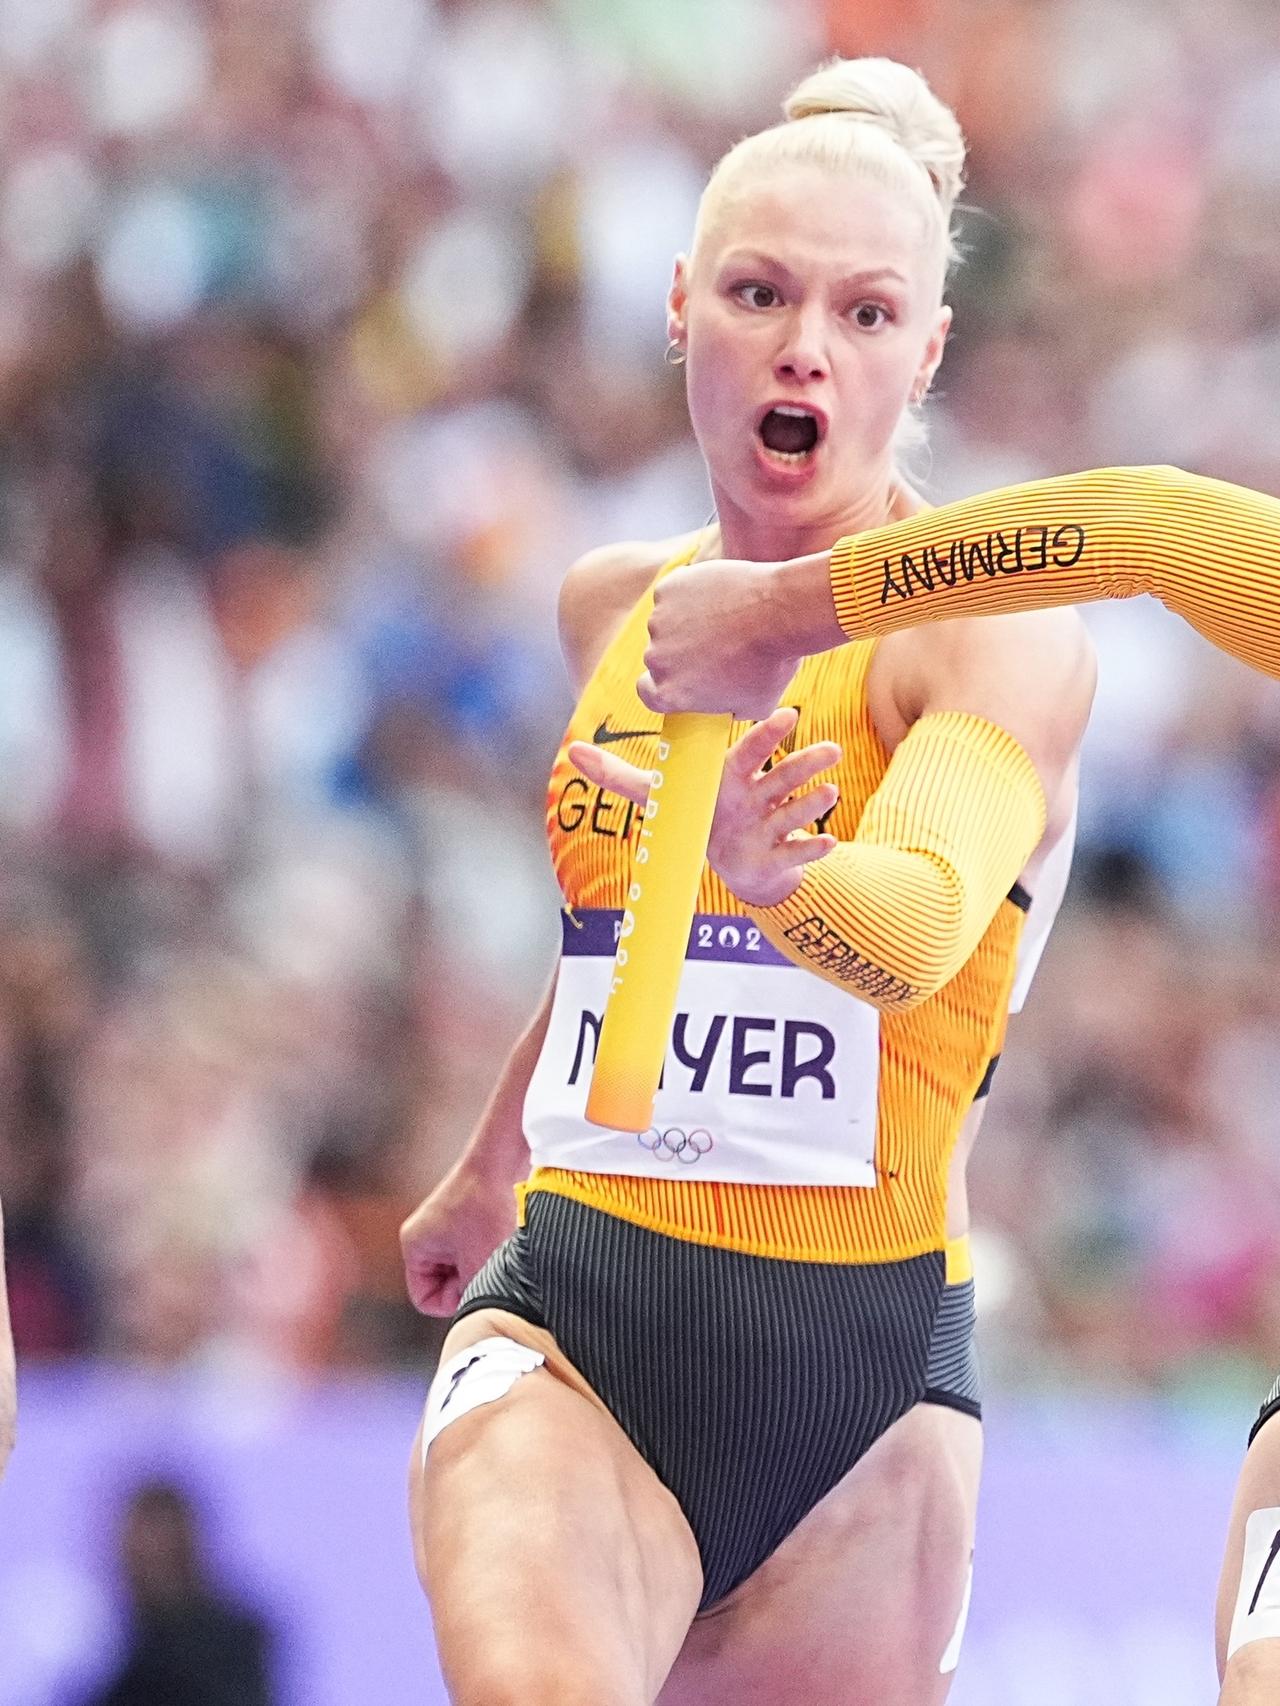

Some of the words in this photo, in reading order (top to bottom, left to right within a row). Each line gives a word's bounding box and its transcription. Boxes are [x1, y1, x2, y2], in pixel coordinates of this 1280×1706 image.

[880, 524, 1086, 604] GERMANY
[698, 924, 761, 951] 202
[567, 1009, 836, 1100] MYER
